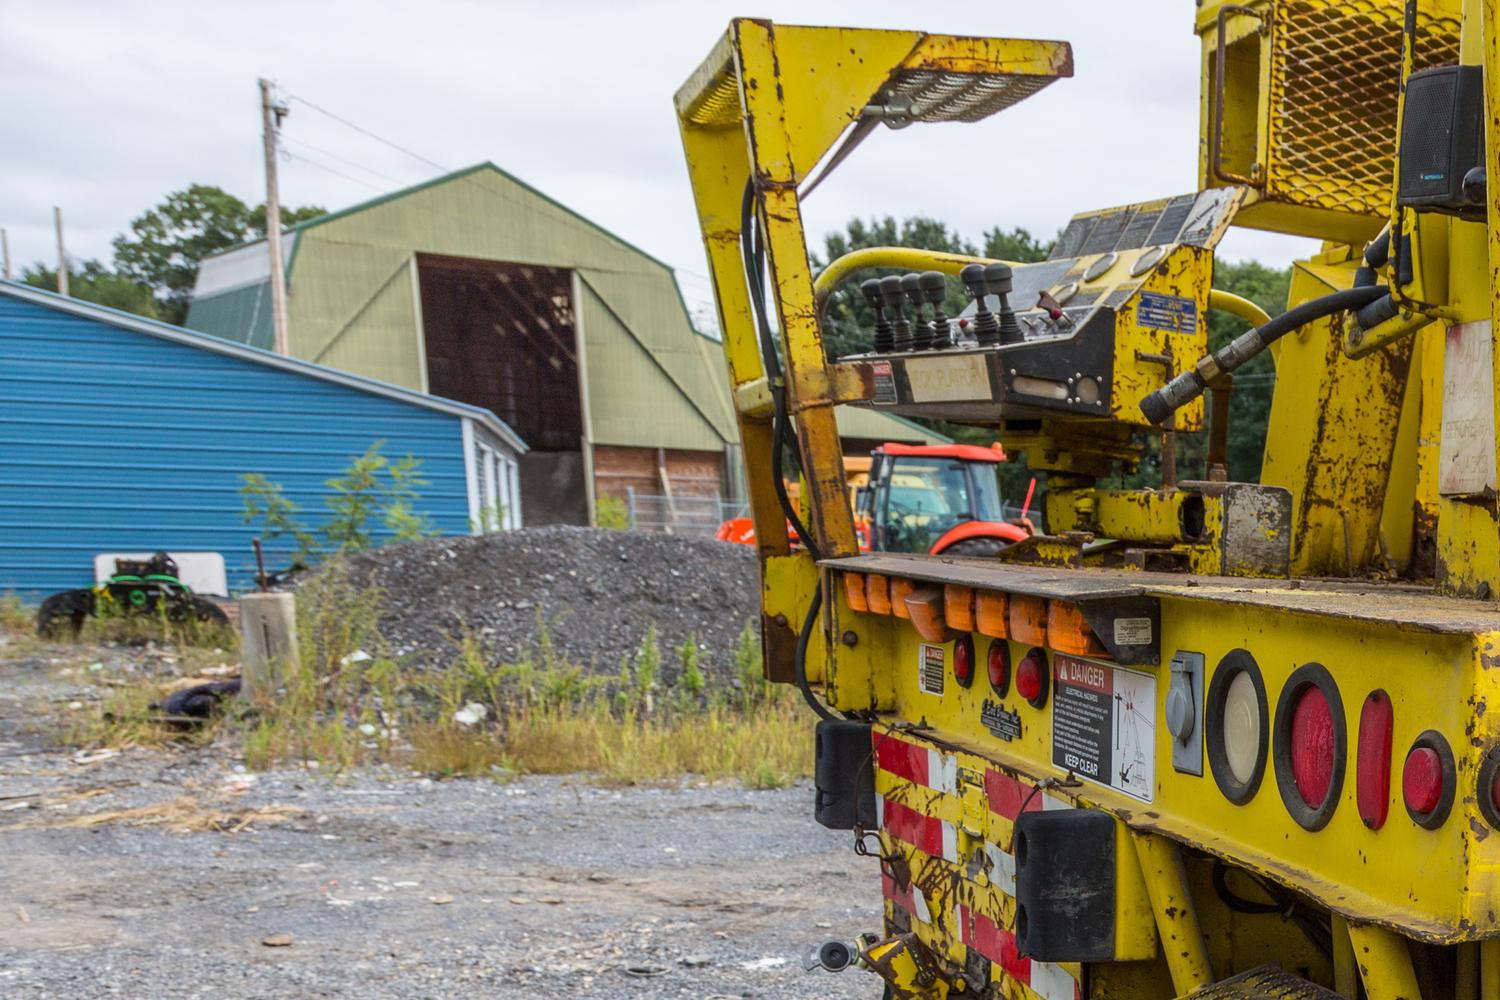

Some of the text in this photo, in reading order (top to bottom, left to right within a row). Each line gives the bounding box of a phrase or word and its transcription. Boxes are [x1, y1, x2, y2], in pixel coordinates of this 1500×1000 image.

[1071, 662, 1104, 688] DANGER
[1065, 752, 1098, 776] KEEP CLEAR
